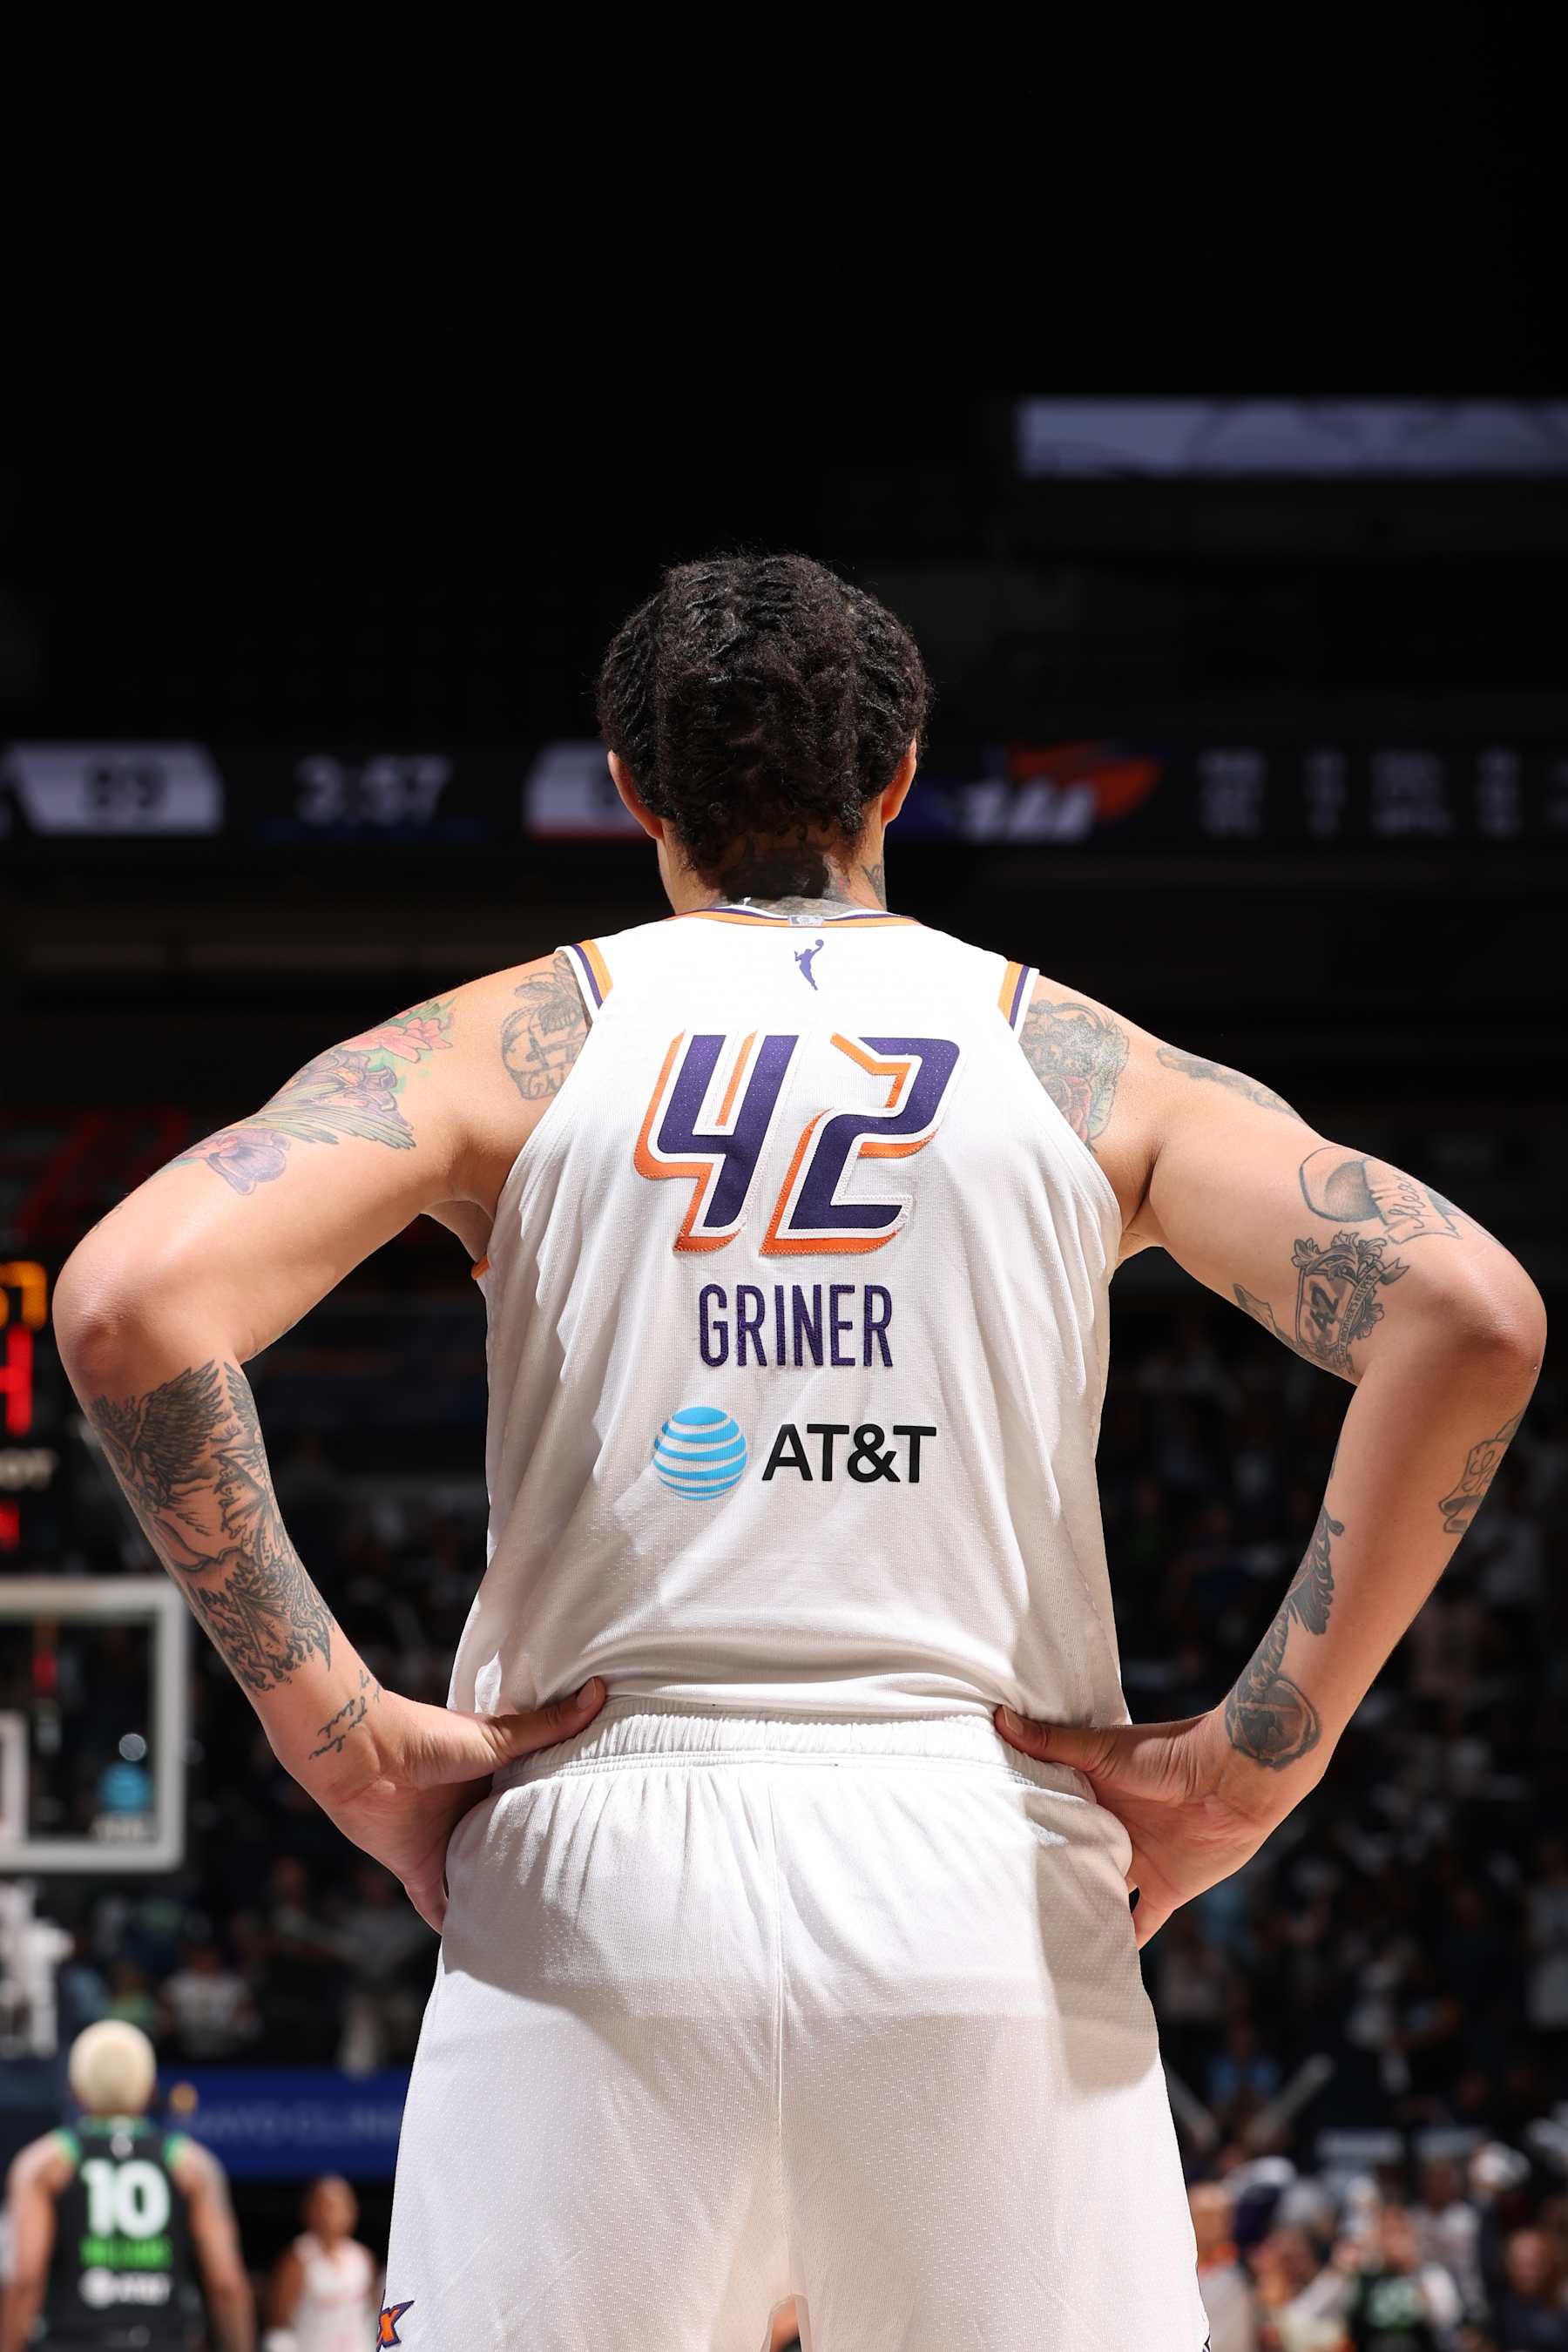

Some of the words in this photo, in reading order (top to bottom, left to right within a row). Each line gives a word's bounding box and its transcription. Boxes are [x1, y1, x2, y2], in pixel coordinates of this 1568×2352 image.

[633, 1030, 960, 1254] 42
[700, 1283, 894, 1368] GRINER
[761, 1423, 937, 1484] AT&T
[81, 2159, 172, 2240] 10
